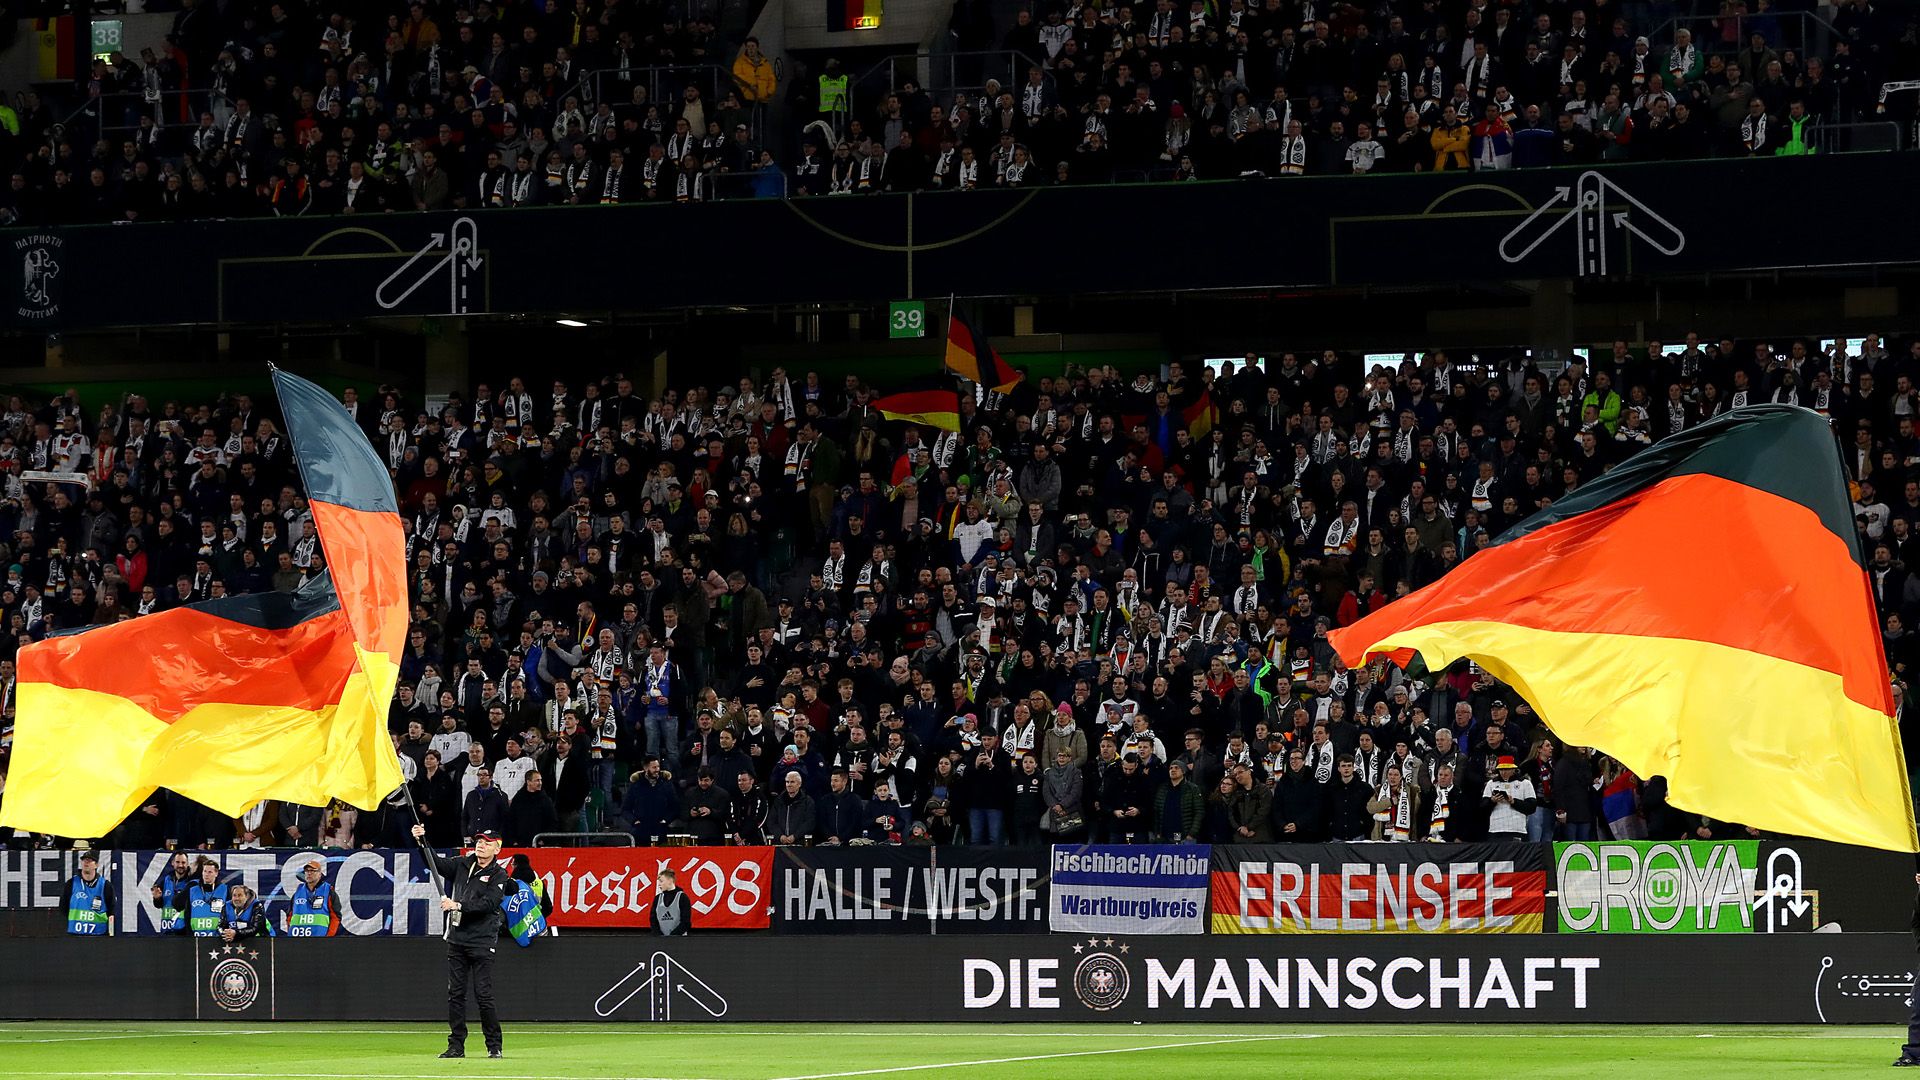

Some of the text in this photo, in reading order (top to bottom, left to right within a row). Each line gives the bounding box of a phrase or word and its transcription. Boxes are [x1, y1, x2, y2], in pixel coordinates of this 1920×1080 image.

[95, 28, 119, 46] 38
[893, 309, 922, 330] 39
[442, 741, 450, 750] 19
[508, 771, 517, 779] 77
[1054, 850, 1208, 876] Fischbach/Rhön
[121, 850, 445, 936] KTSCH
[784, 867, 891, 921] HALLE
[923, 867, 1041, 921] WESTF.
[1238, 860, 1516, 931] ERLENSEE
[1557, 843, 1752, 931] CROYA
[509, 891, 529, 912] UEFA
[1060, 892, 1198, 920] Wartburgkreis
[80, 911, 95, 921] HB
[197, 919, 213, 929] HB
[300, 914, 315, 924] HB
[75, 922, 96, 933] 017
[292, 927, 312, 937] 036
[963, 959, 1060, 1009] DIE
[1145, 957, 1600, 1009] MANNSCHAFT
